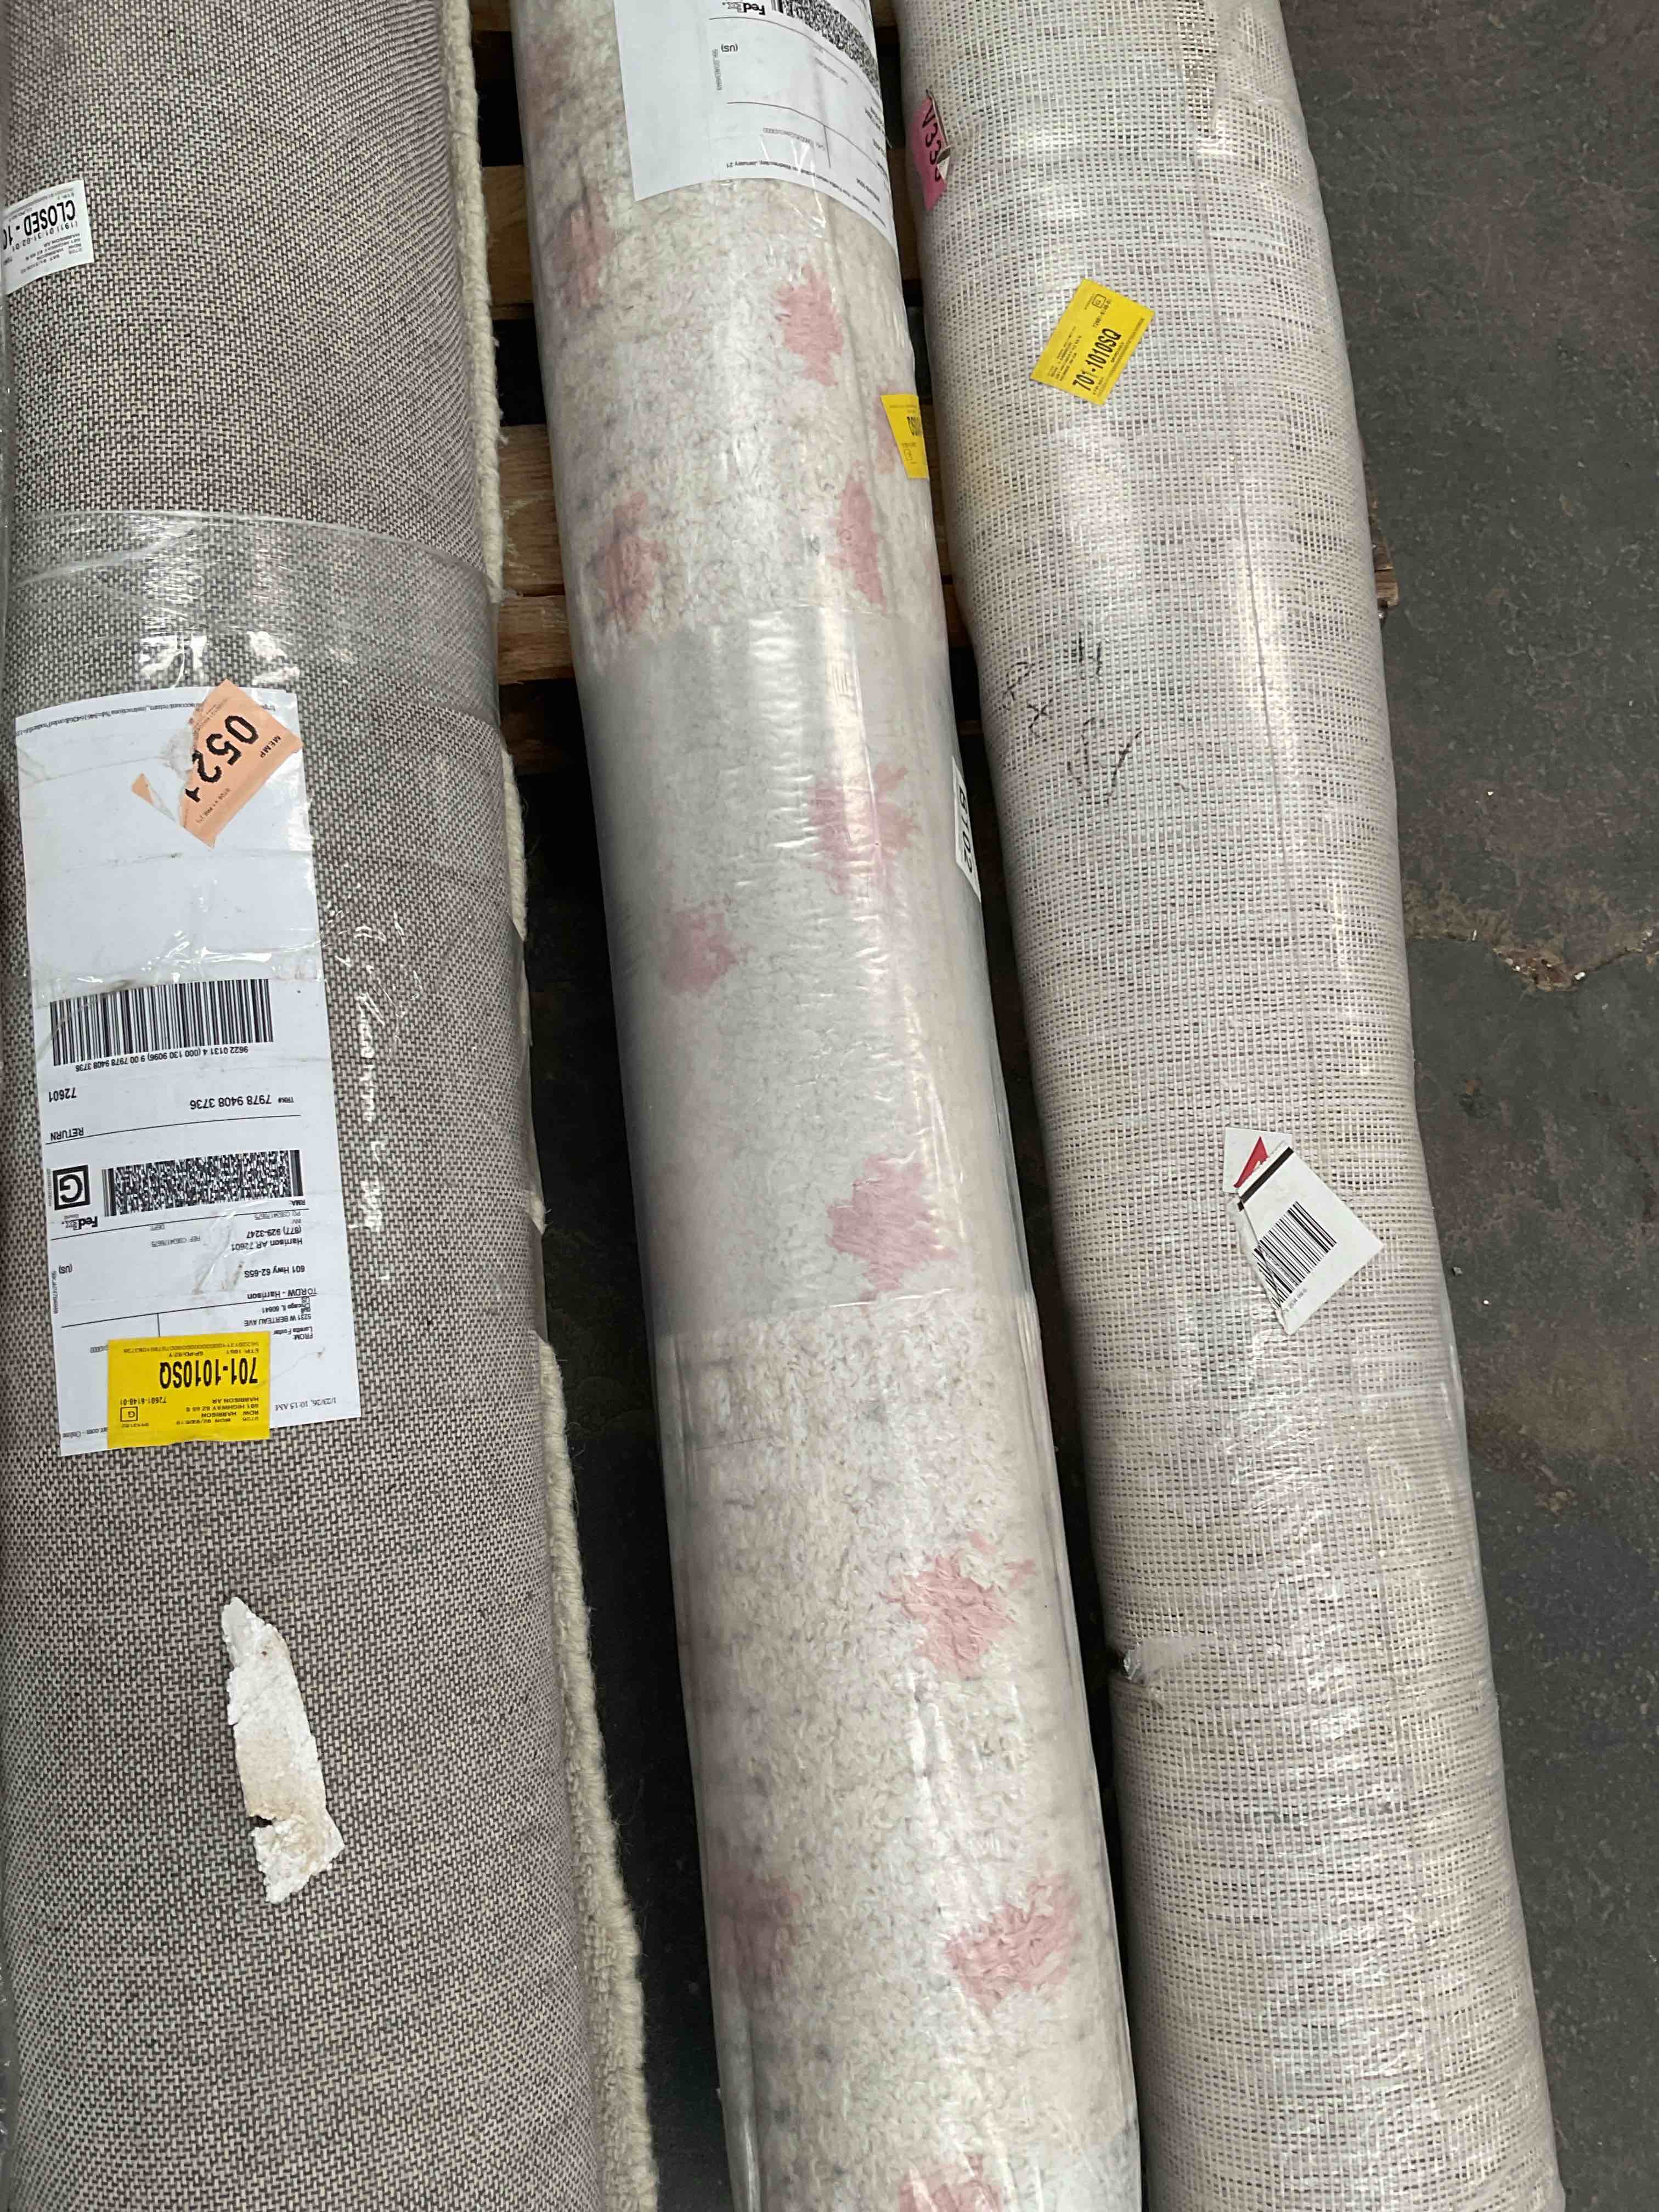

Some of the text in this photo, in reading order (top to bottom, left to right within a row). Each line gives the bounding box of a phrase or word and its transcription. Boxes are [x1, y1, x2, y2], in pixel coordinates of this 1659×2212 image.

[720, 44, 738, 52] (US)
[22, 200, 75, 236] CLOSED
[1071, 329, 1121, 391] 701-1010SQ
[259, 735, 281, 758] MEMP
[185, 1047, 201, 1057] (000
[210, 1047, 228, 1055] 0131
[229, 1045, 248, 1053] 9622
[147, 1051, 167, 1061] 9096)
[75, 1062, 91, 1071] 3736
[92, 1059, 109, 1069] 9408
[110, 1057, 128, 1066] 7978
[48, 1087, 76, 1102] 72601
[246, 1094, 271, 1105] 7978
[189, 1098, 215, 1109] 3736
[218, 1096, 244, 1107] 9408
[50, 1127, 83, 1141] RETURN
[58, 1173, 82, 1202] G
[245, 1226, 301, 1239] (877) 929-3247
[230, 1242, 254, 1250] 72601
[270, 1237, 302, 1247] Harrison
[58, 1263, 72, 1274] (US)
[272, 1265, 290, 1274] Hwy
[247, 1290, 280, 1300] Harrison
[258, 1316, 288, 1324] BERTEAU
[159, 1357, 257, 1389] 701-1010SQ
[275, 1397, 336, 1410] 1/23/26, 10:15 AM
